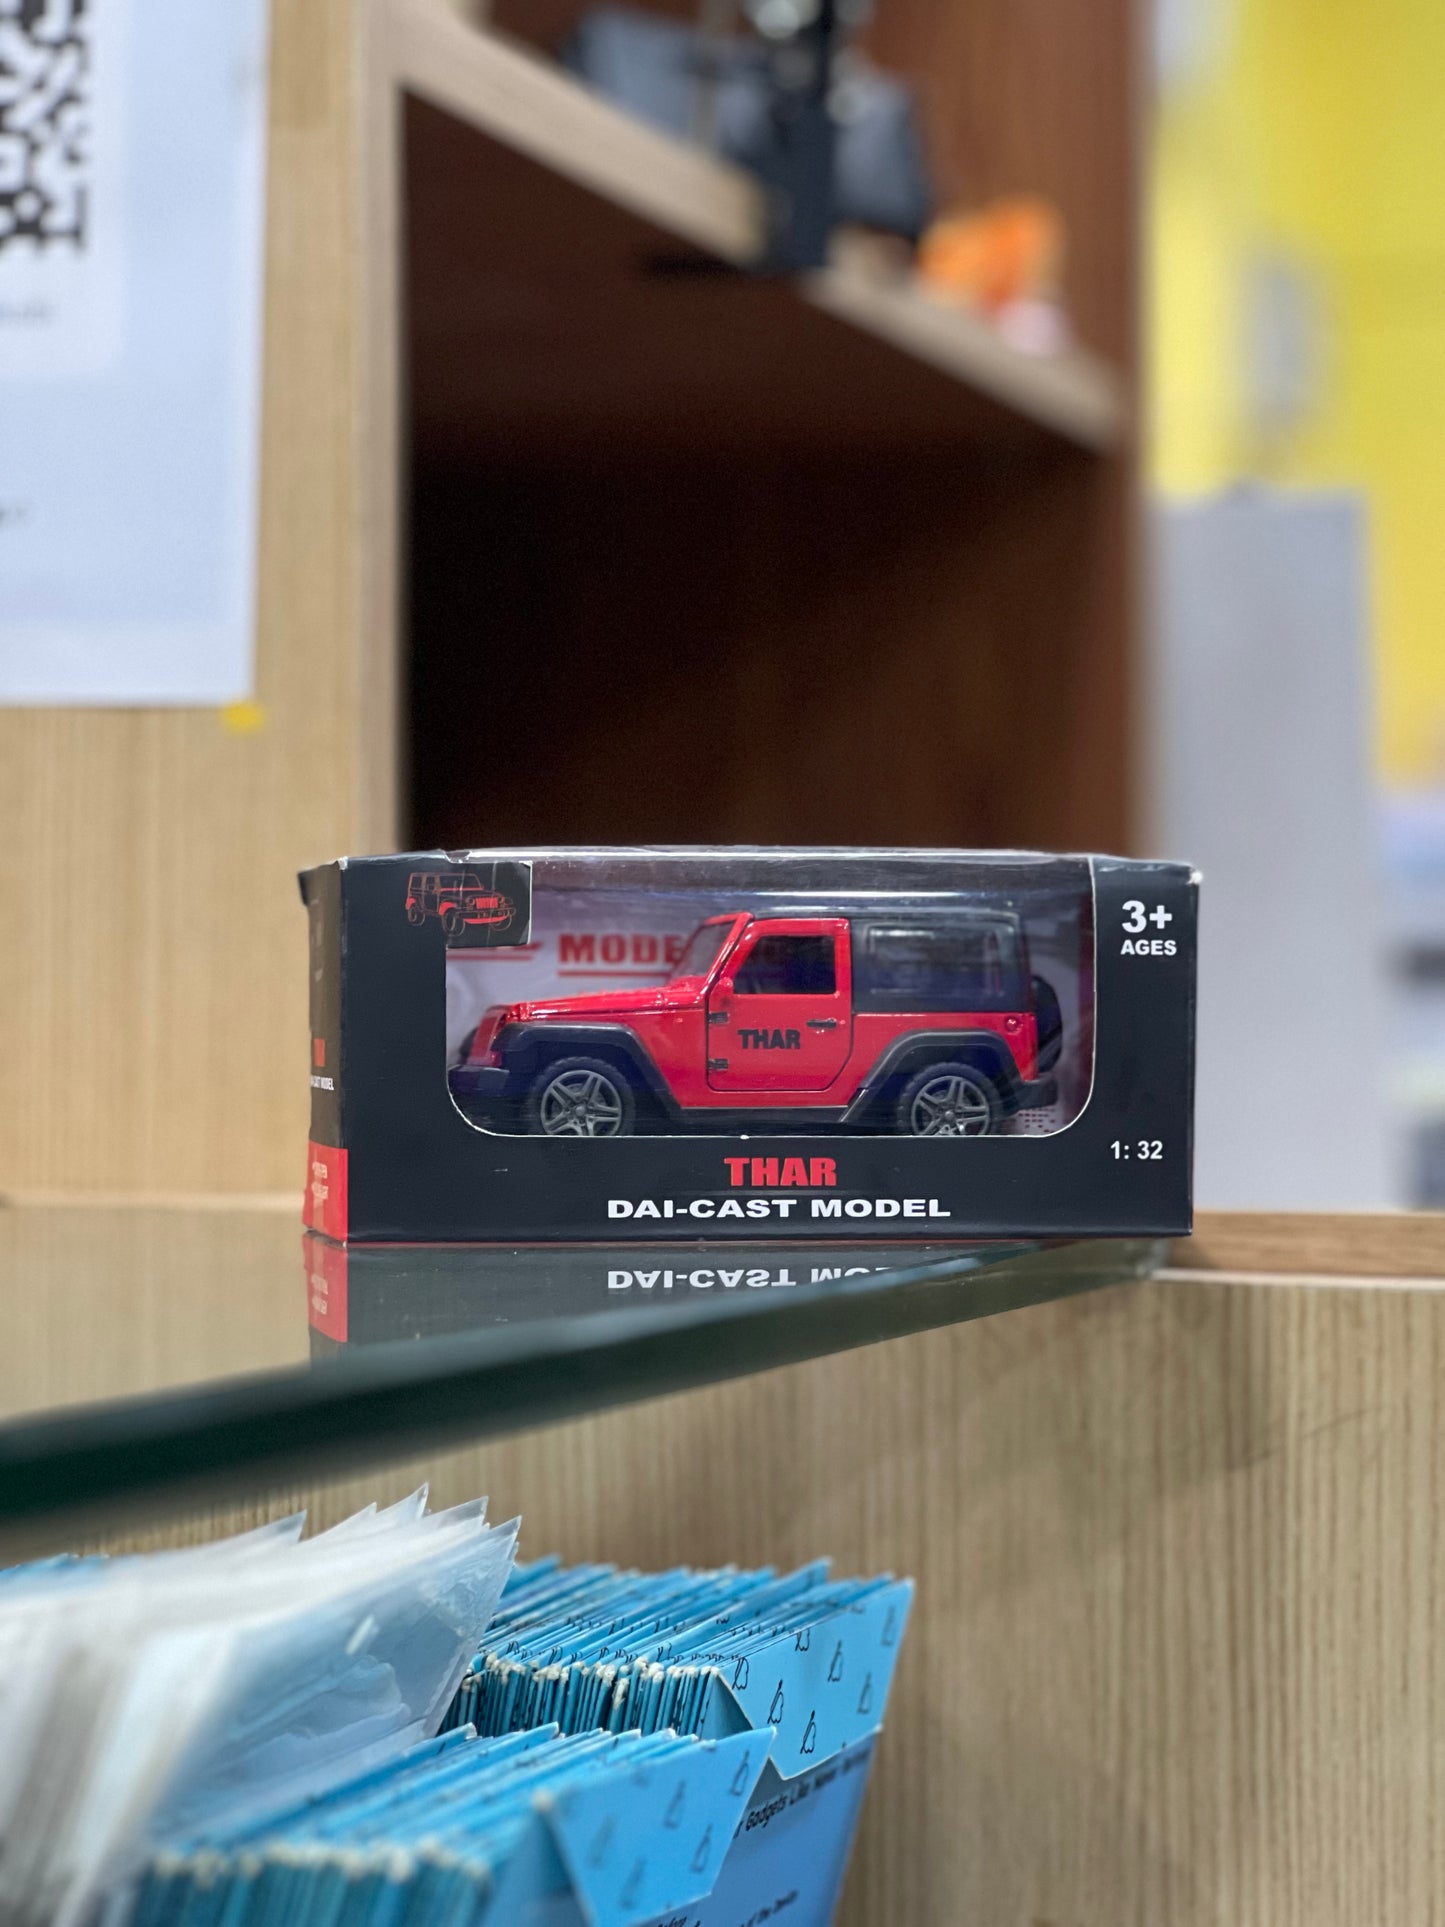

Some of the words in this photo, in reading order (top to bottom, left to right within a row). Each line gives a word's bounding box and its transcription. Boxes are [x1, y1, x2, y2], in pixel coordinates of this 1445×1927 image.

[1121, 899, 1173, 933] 3+
[1120, 939, 1177, 956] AGES
[737, 1028, 801, 1050] THAR
[723, 1157, 837, 1187] THAR
[607, 1199, 797, 1219] DAI-CAST
[811, 1199, 951, 1217] MODEL
